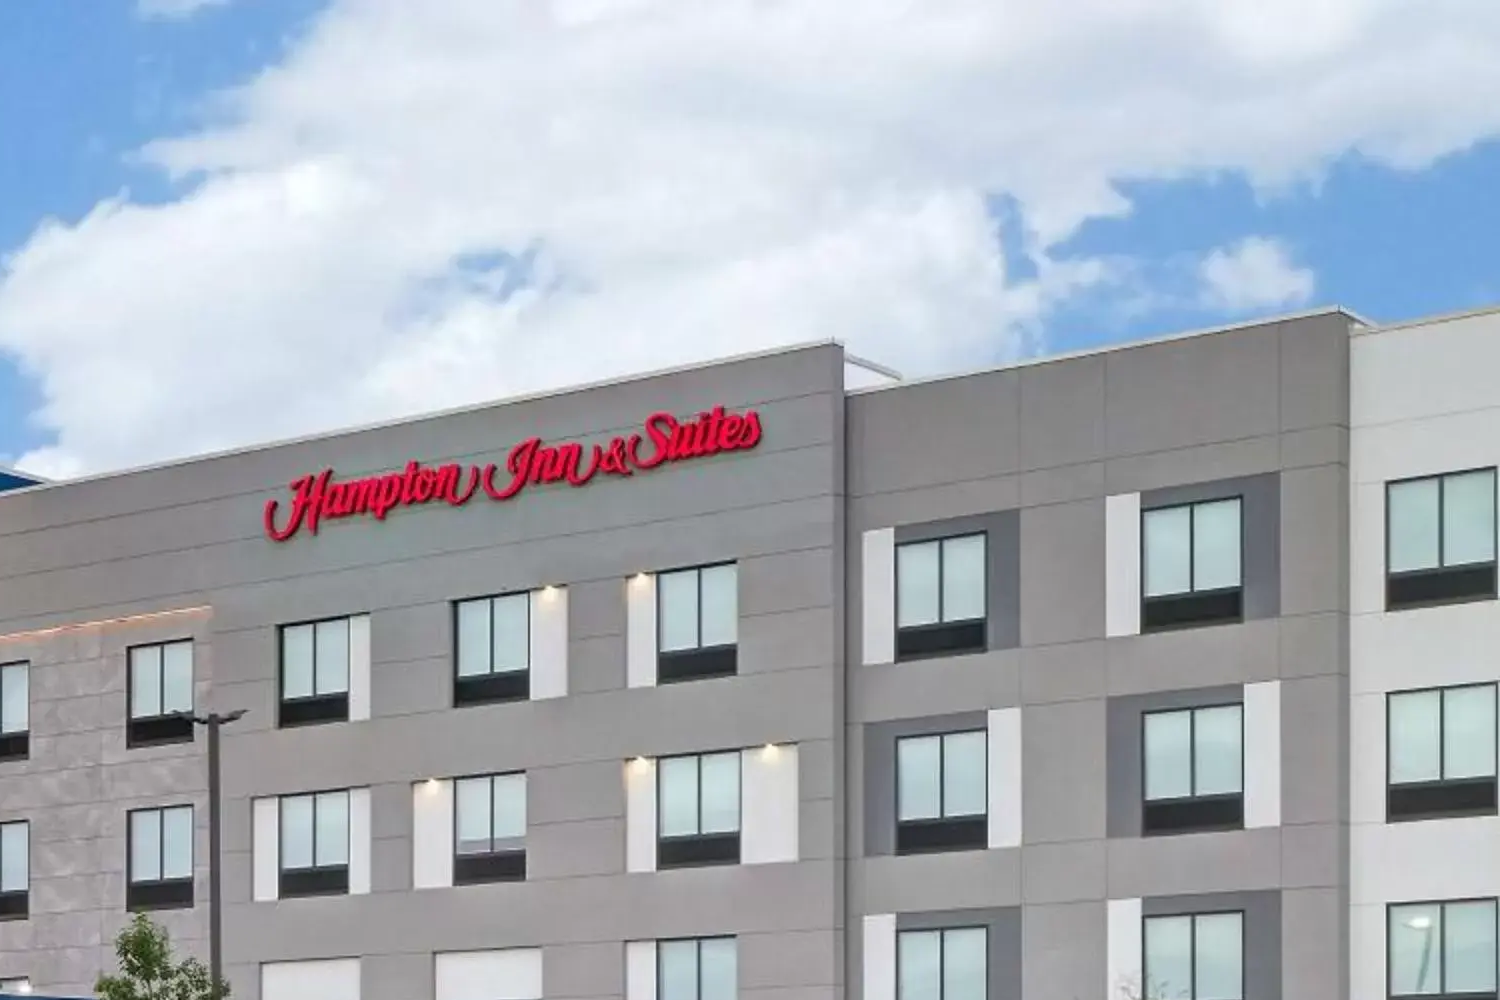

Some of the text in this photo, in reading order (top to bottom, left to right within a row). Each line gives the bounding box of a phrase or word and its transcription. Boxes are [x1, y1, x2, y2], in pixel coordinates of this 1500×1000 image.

[264, 404, 763, 543] Hampton Inn & Suites
